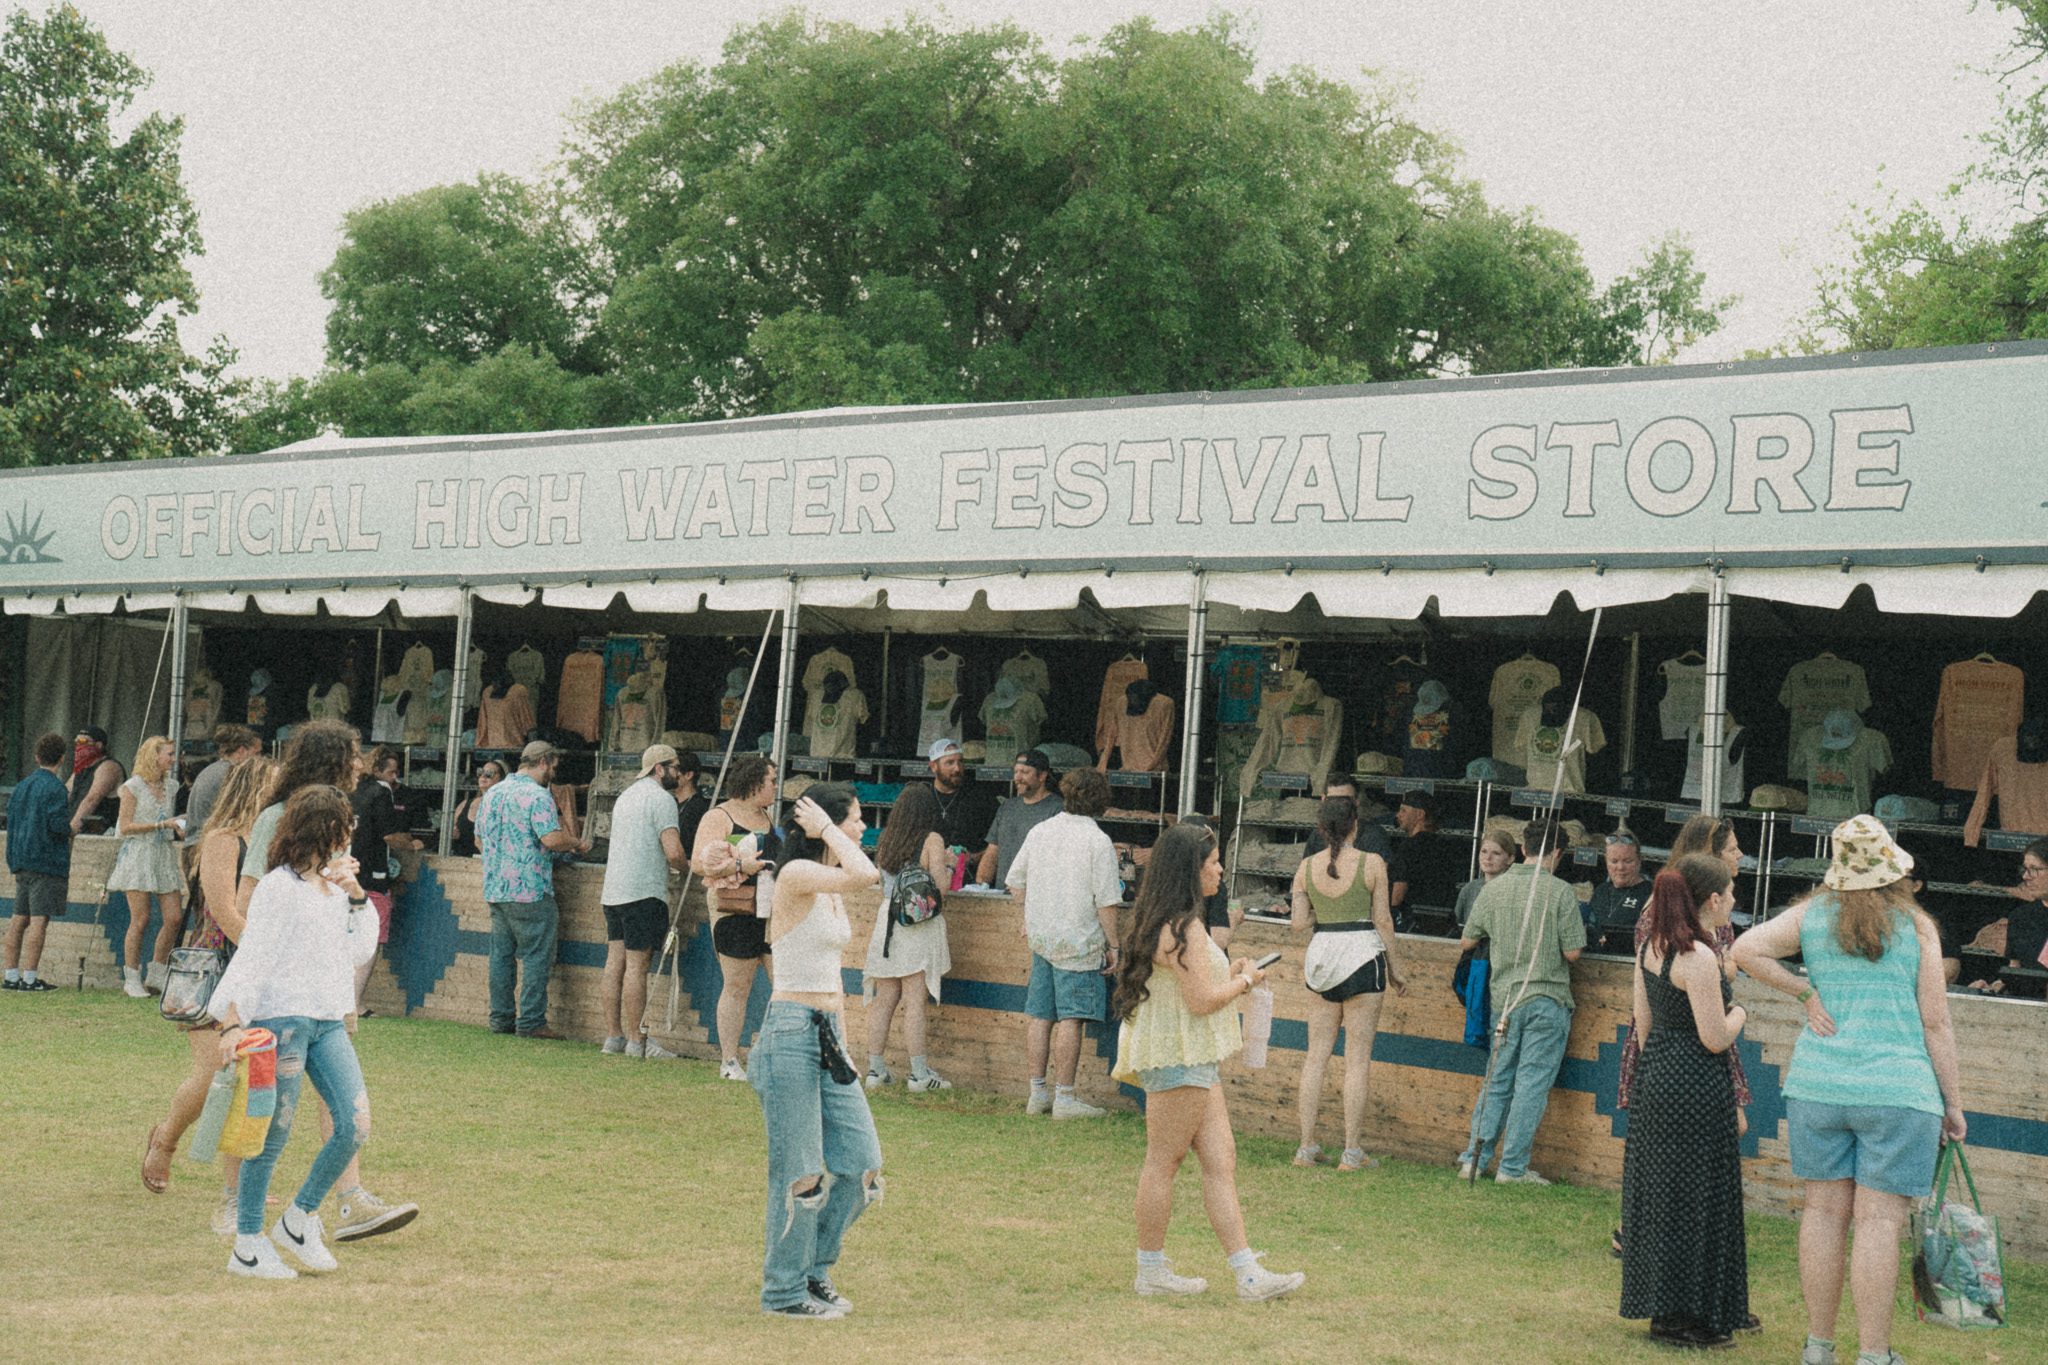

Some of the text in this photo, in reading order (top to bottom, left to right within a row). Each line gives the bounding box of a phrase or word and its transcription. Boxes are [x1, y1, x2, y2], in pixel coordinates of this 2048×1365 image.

[100, 403, 1914, 560] OFFICIAL HIGH WATER FESTIVAL STORE
